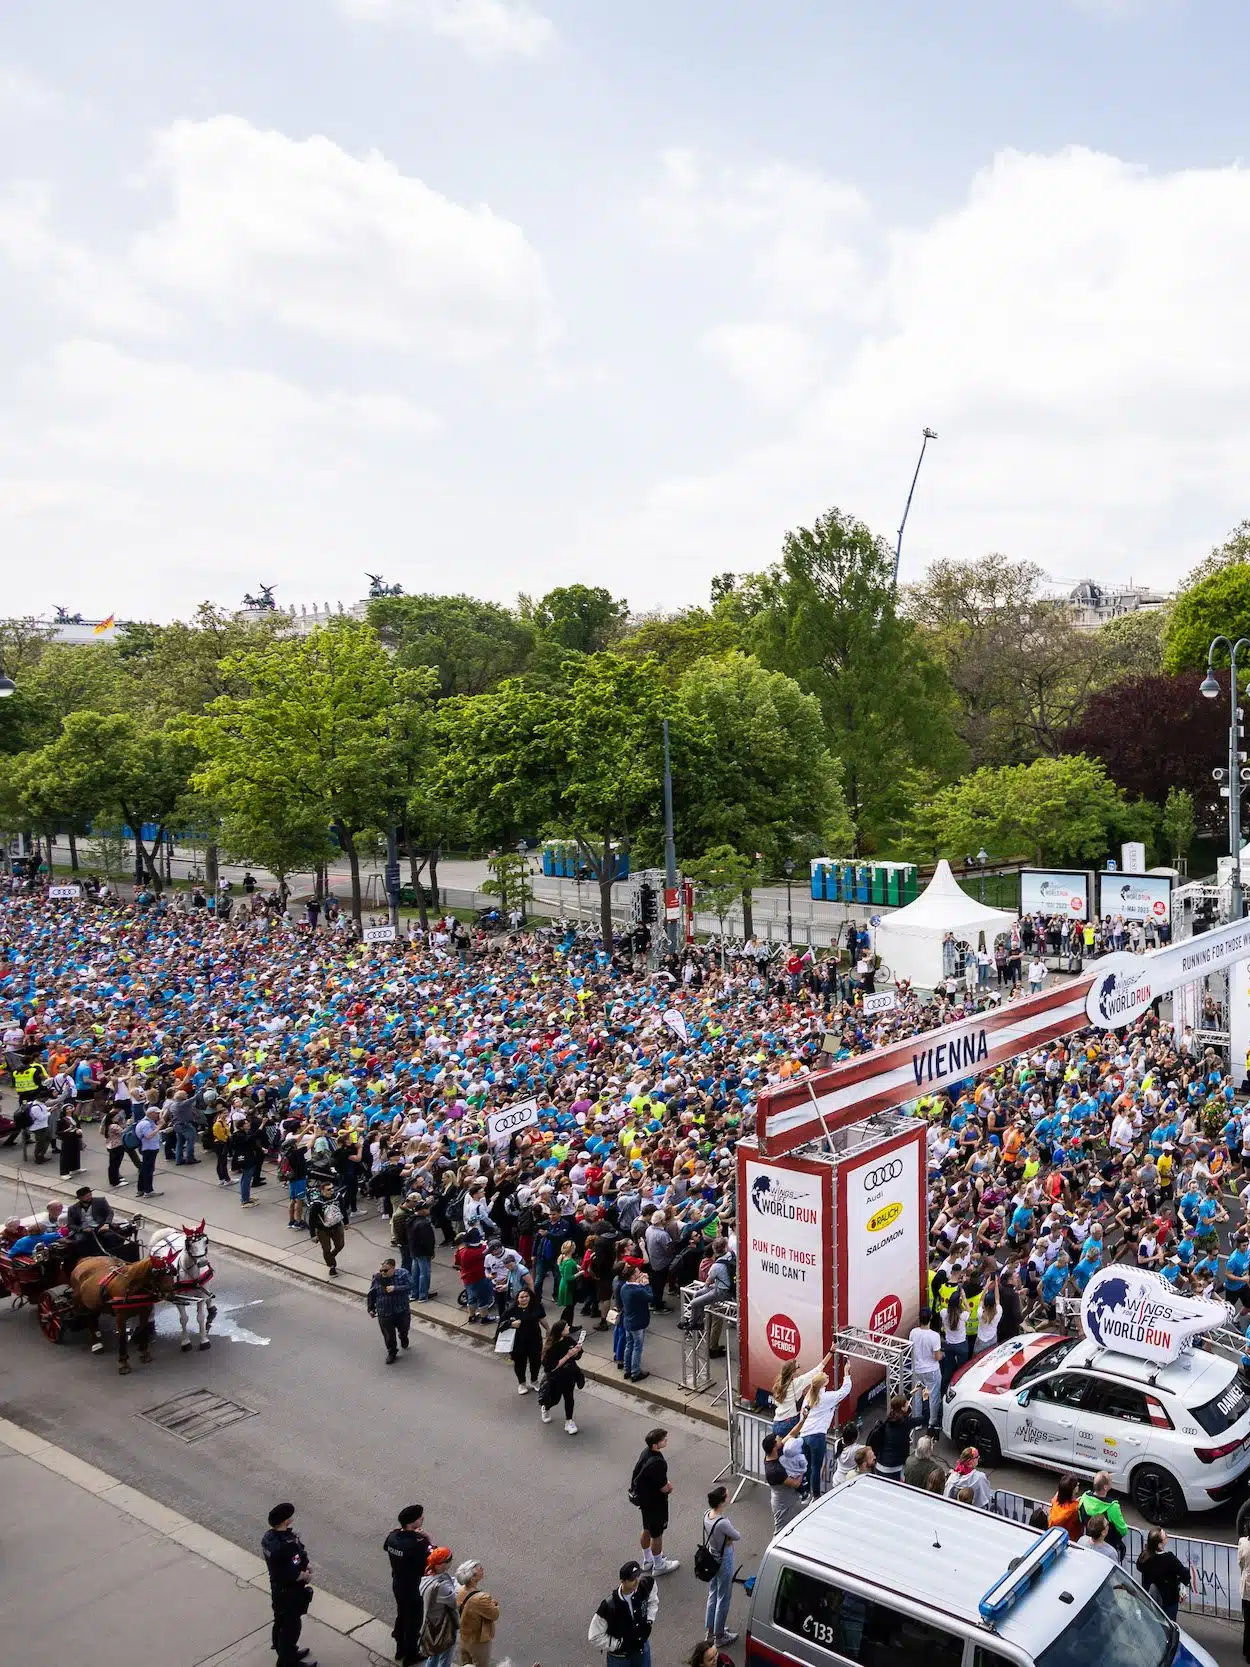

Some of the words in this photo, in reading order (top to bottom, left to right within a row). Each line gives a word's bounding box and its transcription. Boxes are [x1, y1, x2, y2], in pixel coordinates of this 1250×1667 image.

[1182, 948, 1211, 972] RUNNING
[1212, 943, 1224, 960] FOR
[1225, 935, 1242, 955] THOSE
[912, 1029, 989, 1087] VIENNA
[865, 1191, 884, 1205] Audi
[876, 1206, 900, 1225] RAUCH
[752, 1238, 768, 1254] RUN
[770, 1244, 786, 1260] FOR
[788, 1249, 817, 1267] THOSE
[866, 1228, 904, 1256] SALOMON
[761, 1258, 780, 1276] WHO
[873, 1301, 898, 1330] JETZT
[1127, 1298, 1173, 1319] WINGS
[1130, 1313, 1159, 1328] LIFE
[770, 1323, 796, 1344] JETZT
[771, 1338, 796, 1354] SPENDEN
[1216, 1384, 1245, 1416] DANKE!
[1019, 1425, 1048, 1440] WINGS
[1023, 1434, 1040, 1446] LIFE
[1103, 1449, 1118, 1457] ERGO
[813, 1621, 834, 1644] 133
